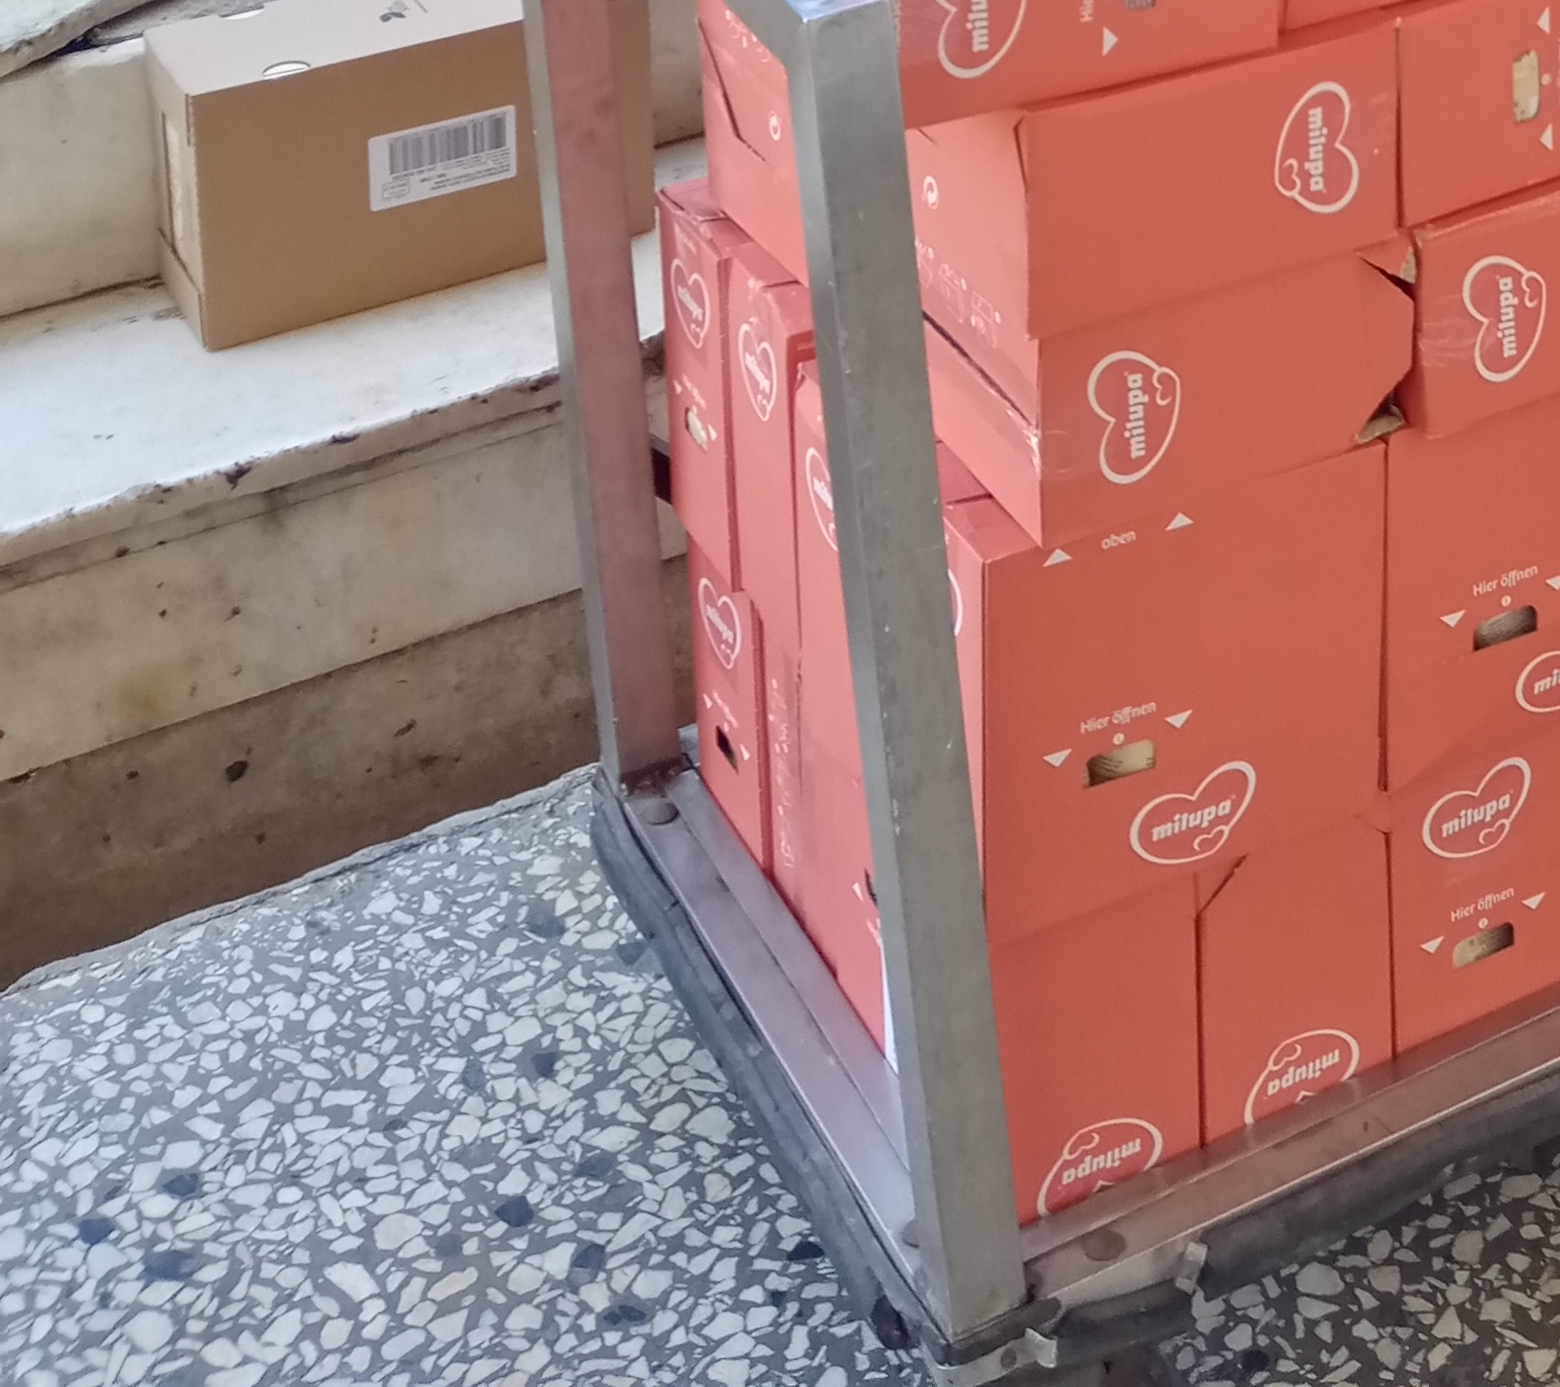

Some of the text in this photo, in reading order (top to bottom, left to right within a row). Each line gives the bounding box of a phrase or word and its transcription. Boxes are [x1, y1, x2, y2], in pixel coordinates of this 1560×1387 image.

[1304, 107, 1328, 192] milupa
[1497, 276, 1519, 358] milupa
[1124, 373, 1149, 459] milupa
[1101, 531, 1136, 550] oben
[1473, 565, 1538, 596] Hier öffnen
[1080, 701, 1157, 734] Hier öffnen
[1151, 798, 1232, 842] milupa
[1441, 793, 1511, 838] milupa
[1450, 887, 1515, 922] Hier öffnen
[1266, 1049, 1341, 1096] milupa
[1061, 1138, 1142, 1185] milupa
